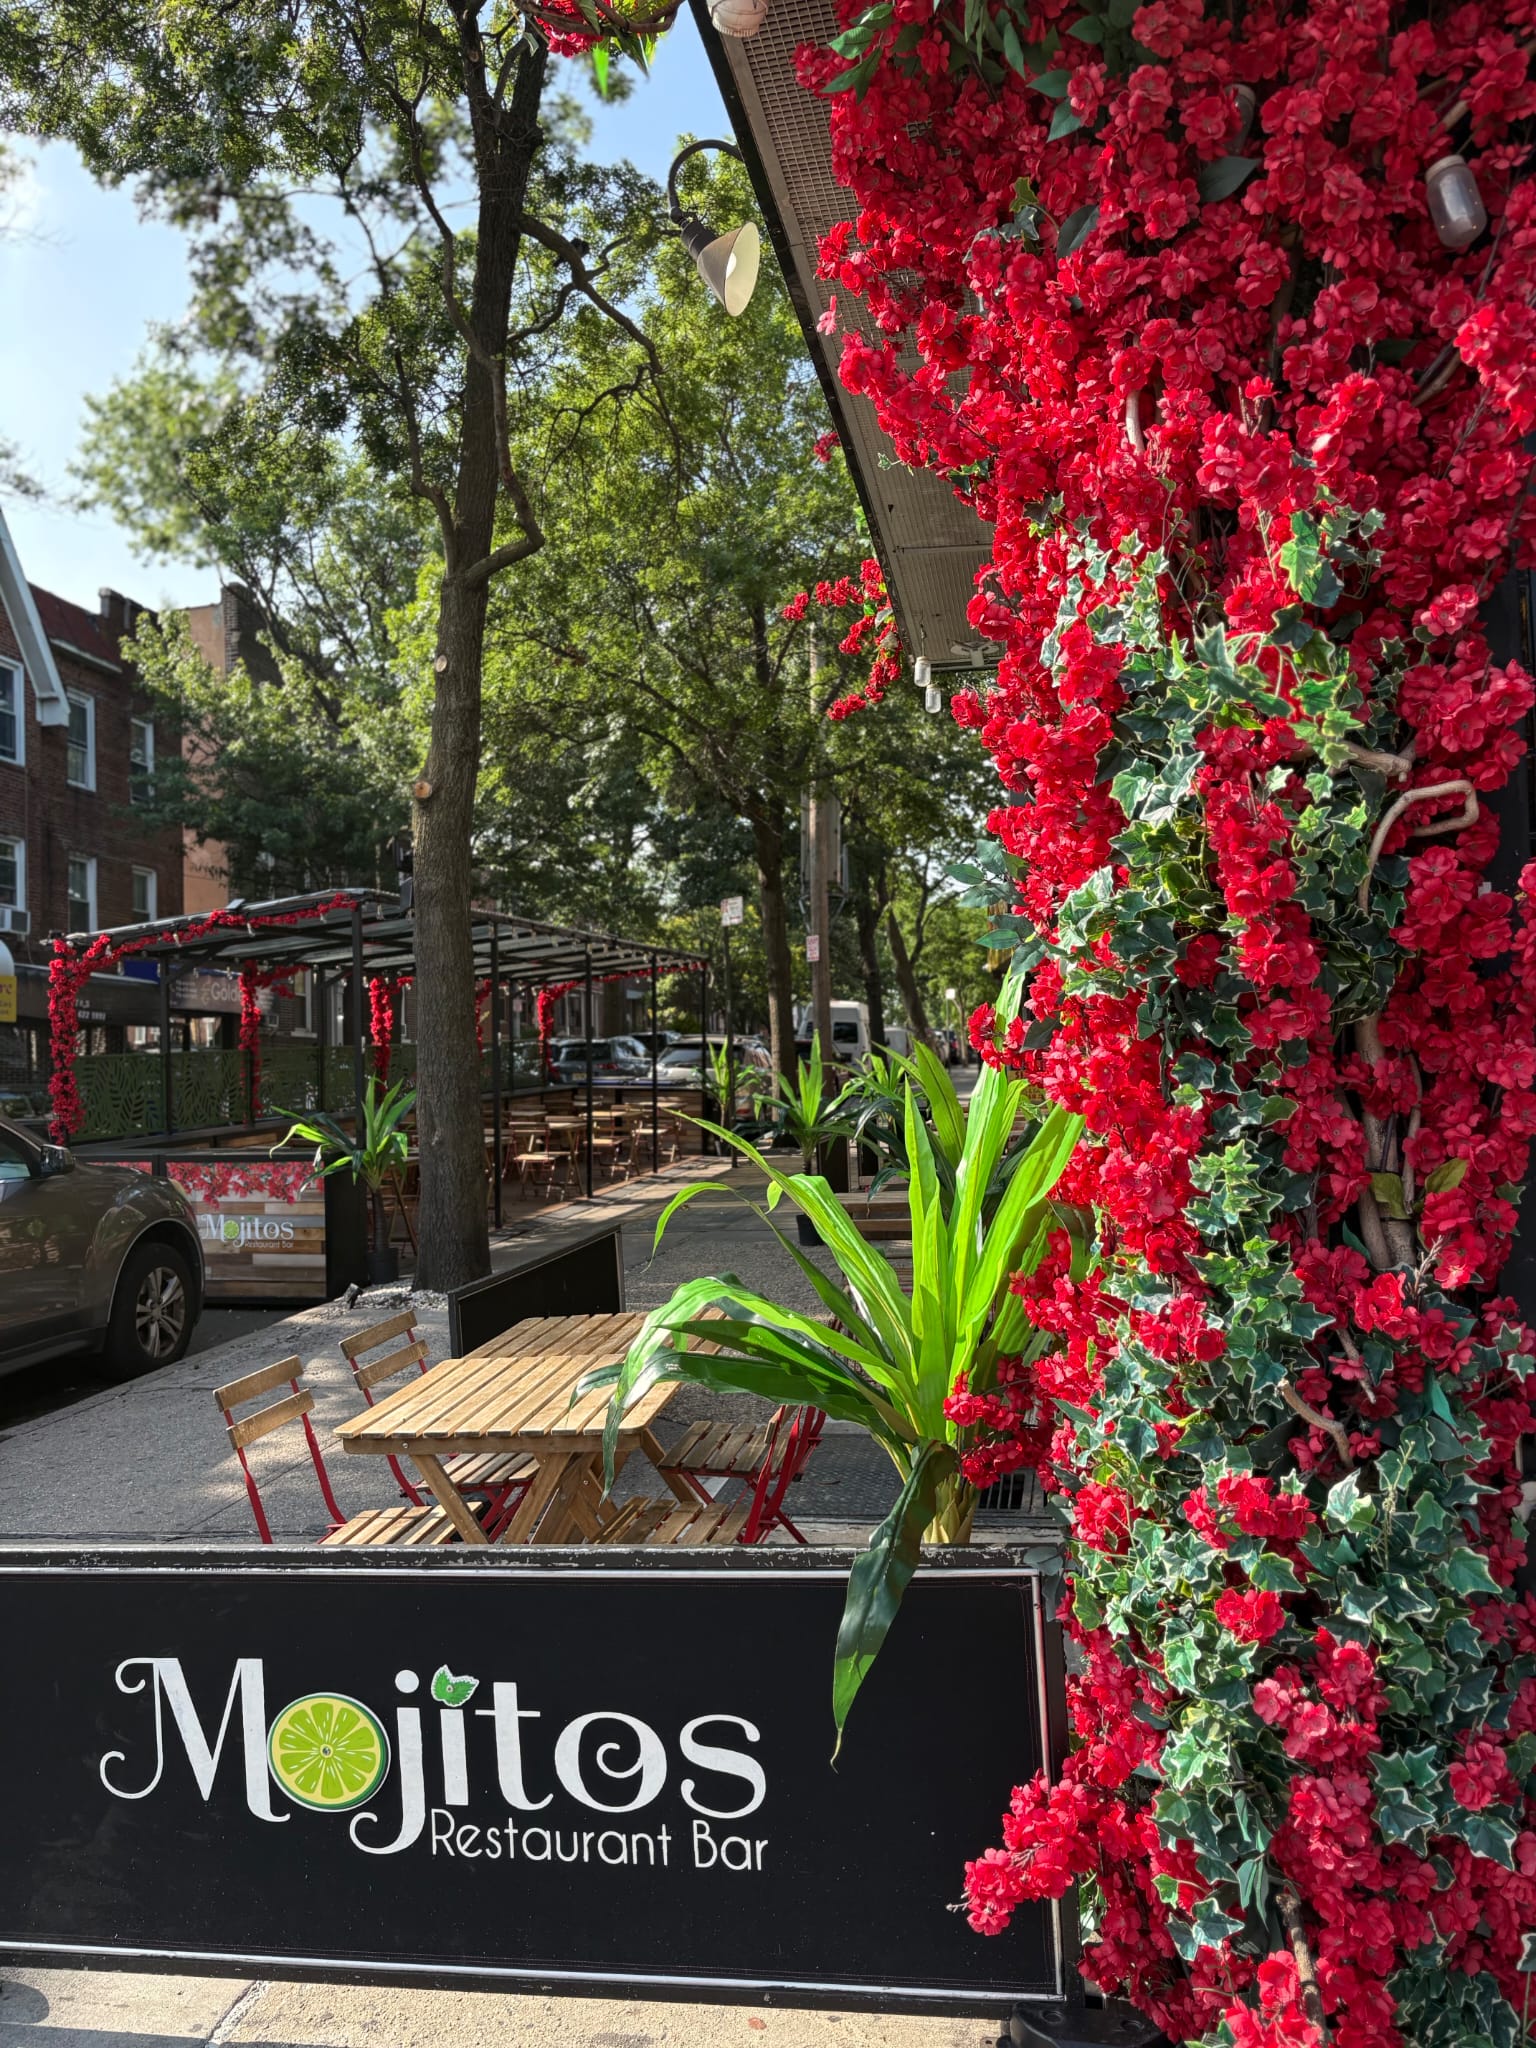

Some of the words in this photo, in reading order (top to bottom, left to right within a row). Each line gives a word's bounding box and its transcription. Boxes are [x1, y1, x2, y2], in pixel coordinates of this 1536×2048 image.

[198, 1213, 294, 1248] Mojitos
[244, 1240, 280, 1248] Restaurant
[99, 1657, 767, 1856] Mojitos
[431, 1808, 672, 1866] Restaurant
[692, 1819, 769, 1872] Bar
